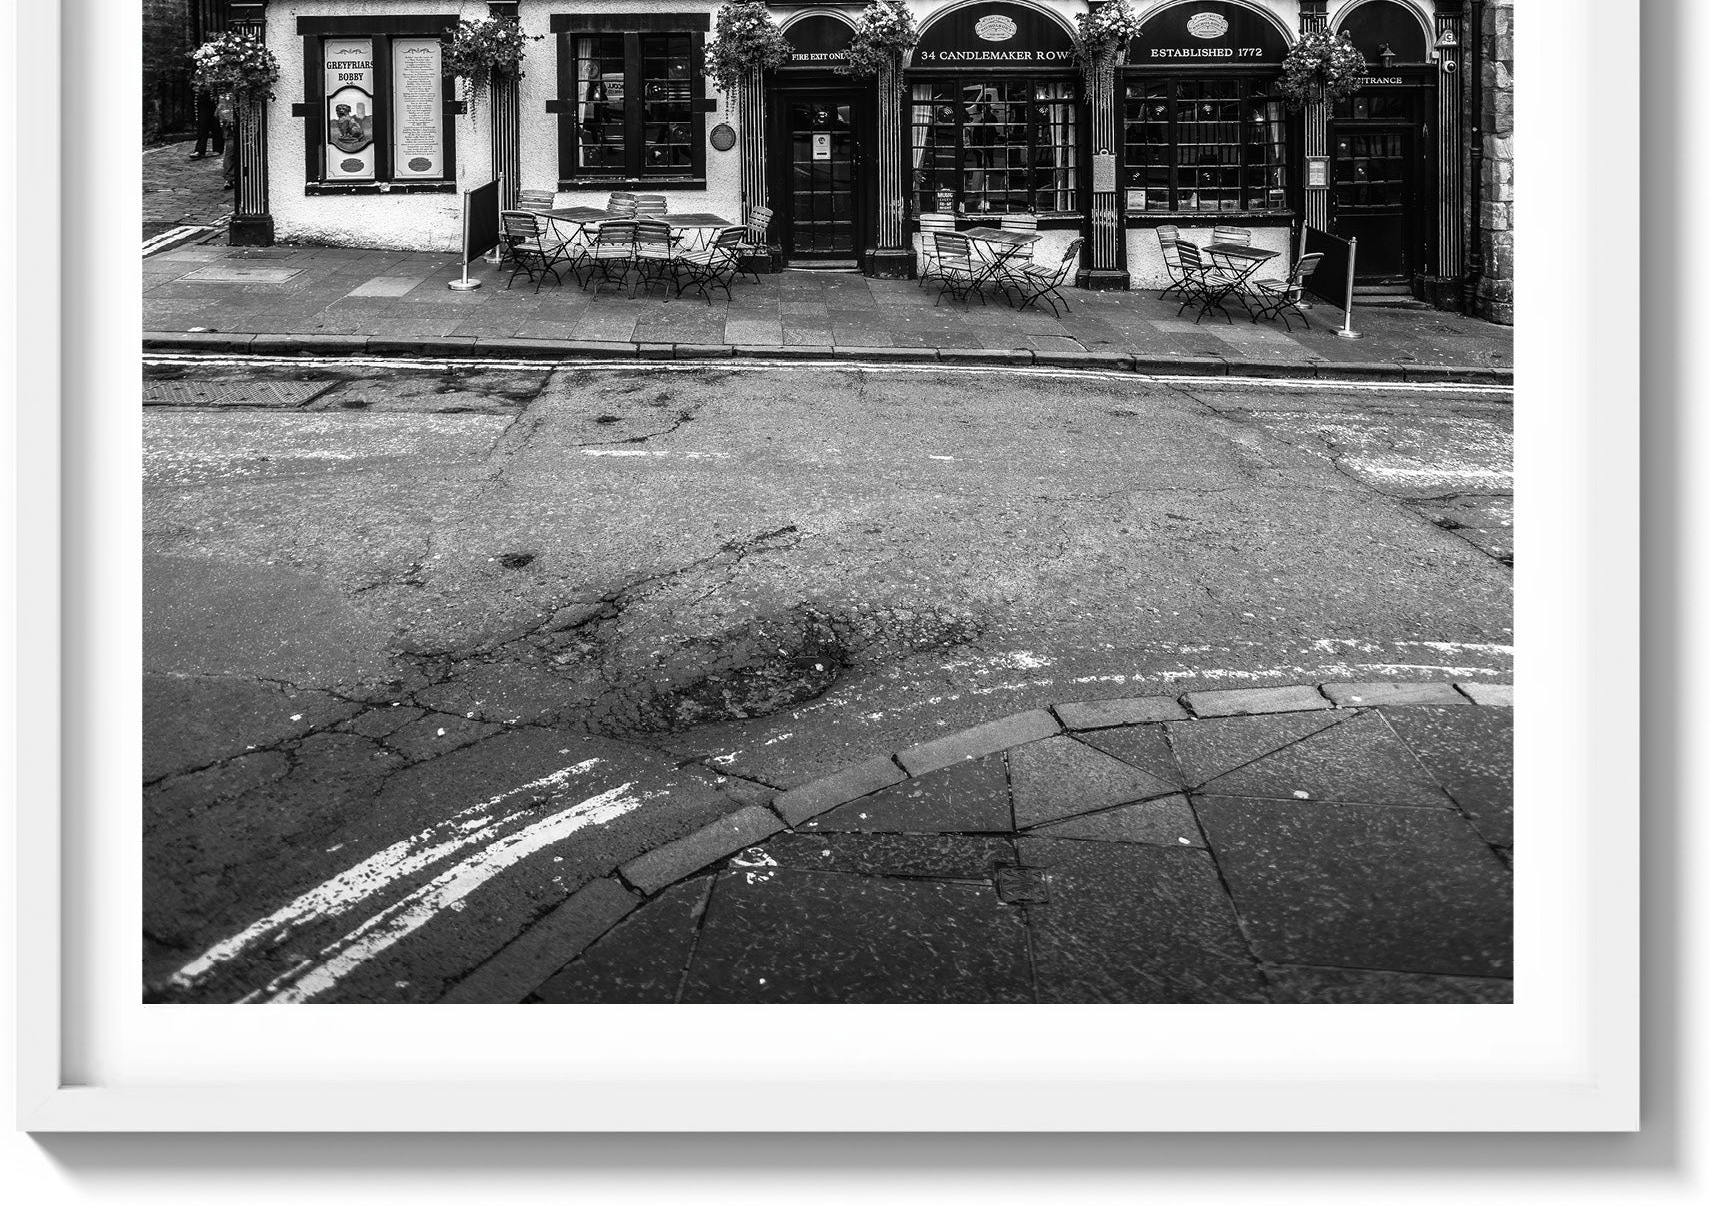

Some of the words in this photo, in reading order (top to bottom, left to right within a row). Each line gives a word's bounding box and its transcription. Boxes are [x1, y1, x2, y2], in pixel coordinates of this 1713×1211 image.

[791, 53, 810, 61] FIRE
[828, 52, 846, 60] ONL
[921, 50, 936, 60] 34
[939, 50, 1032, 60] CANDLEMAKER
[1036, 50, 1069, 60] ROW
[1150, 48, 1234, 58] ESTABLISHED
[1238, 47, 1263, 57] 1772
[326, 60, 375, 70] GREYFRIARS
[338, 72, 364, 81] BOBBY
